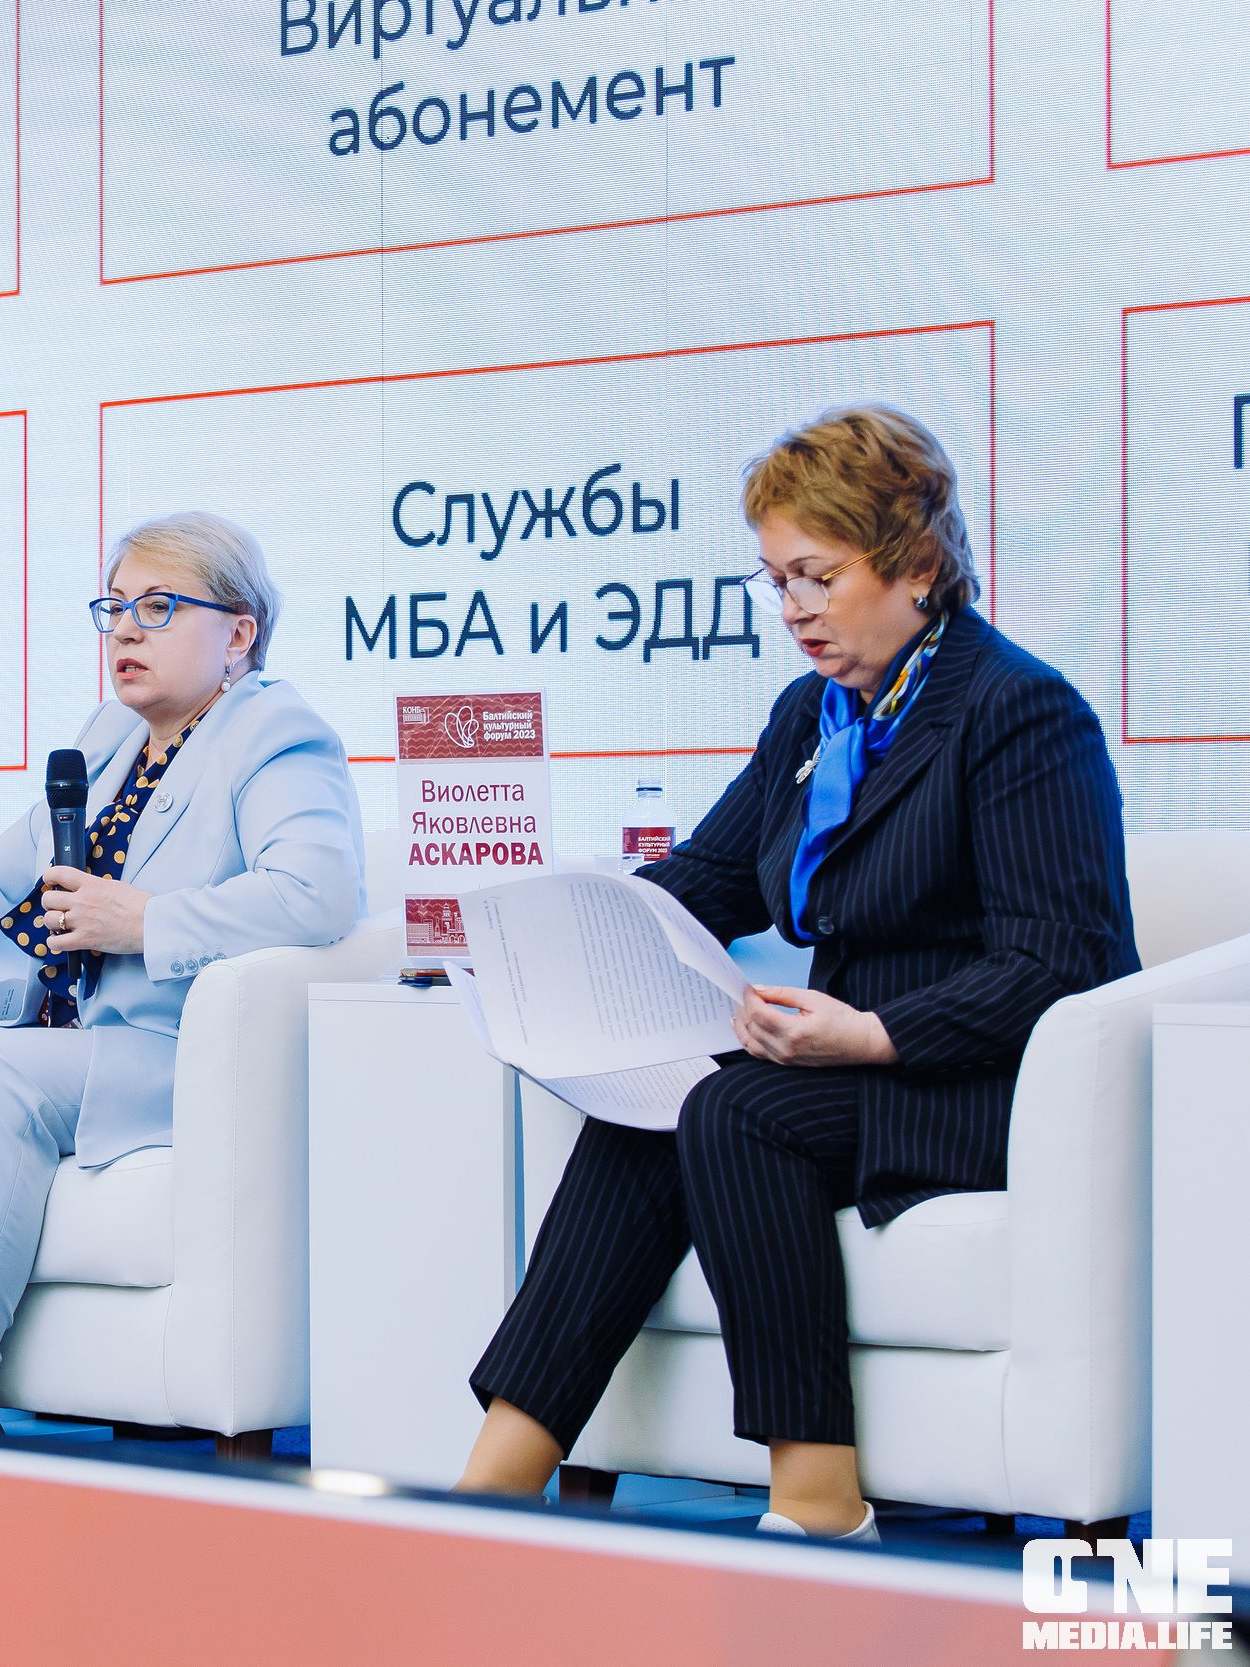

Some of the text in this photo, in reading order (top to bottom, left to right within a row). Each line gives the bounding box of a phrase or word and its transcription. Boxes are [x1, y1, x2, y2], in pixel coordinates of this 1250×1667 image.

[328, 55, 736, 157] абонемент
[392, 463, 680, 562] Службы
[345, 575, 761, 663] МБА и ЭДД
[482, 709, 533, 721] Балтийский
[483, 719, 532, 731] культурный
[483, 729, 536, 741] форум 2023
[421, 779, 525, 803] Виолетта
[412, 811, 537, 835] Яковлевна
[408, 841, 545, 866] АСКАРОВА
